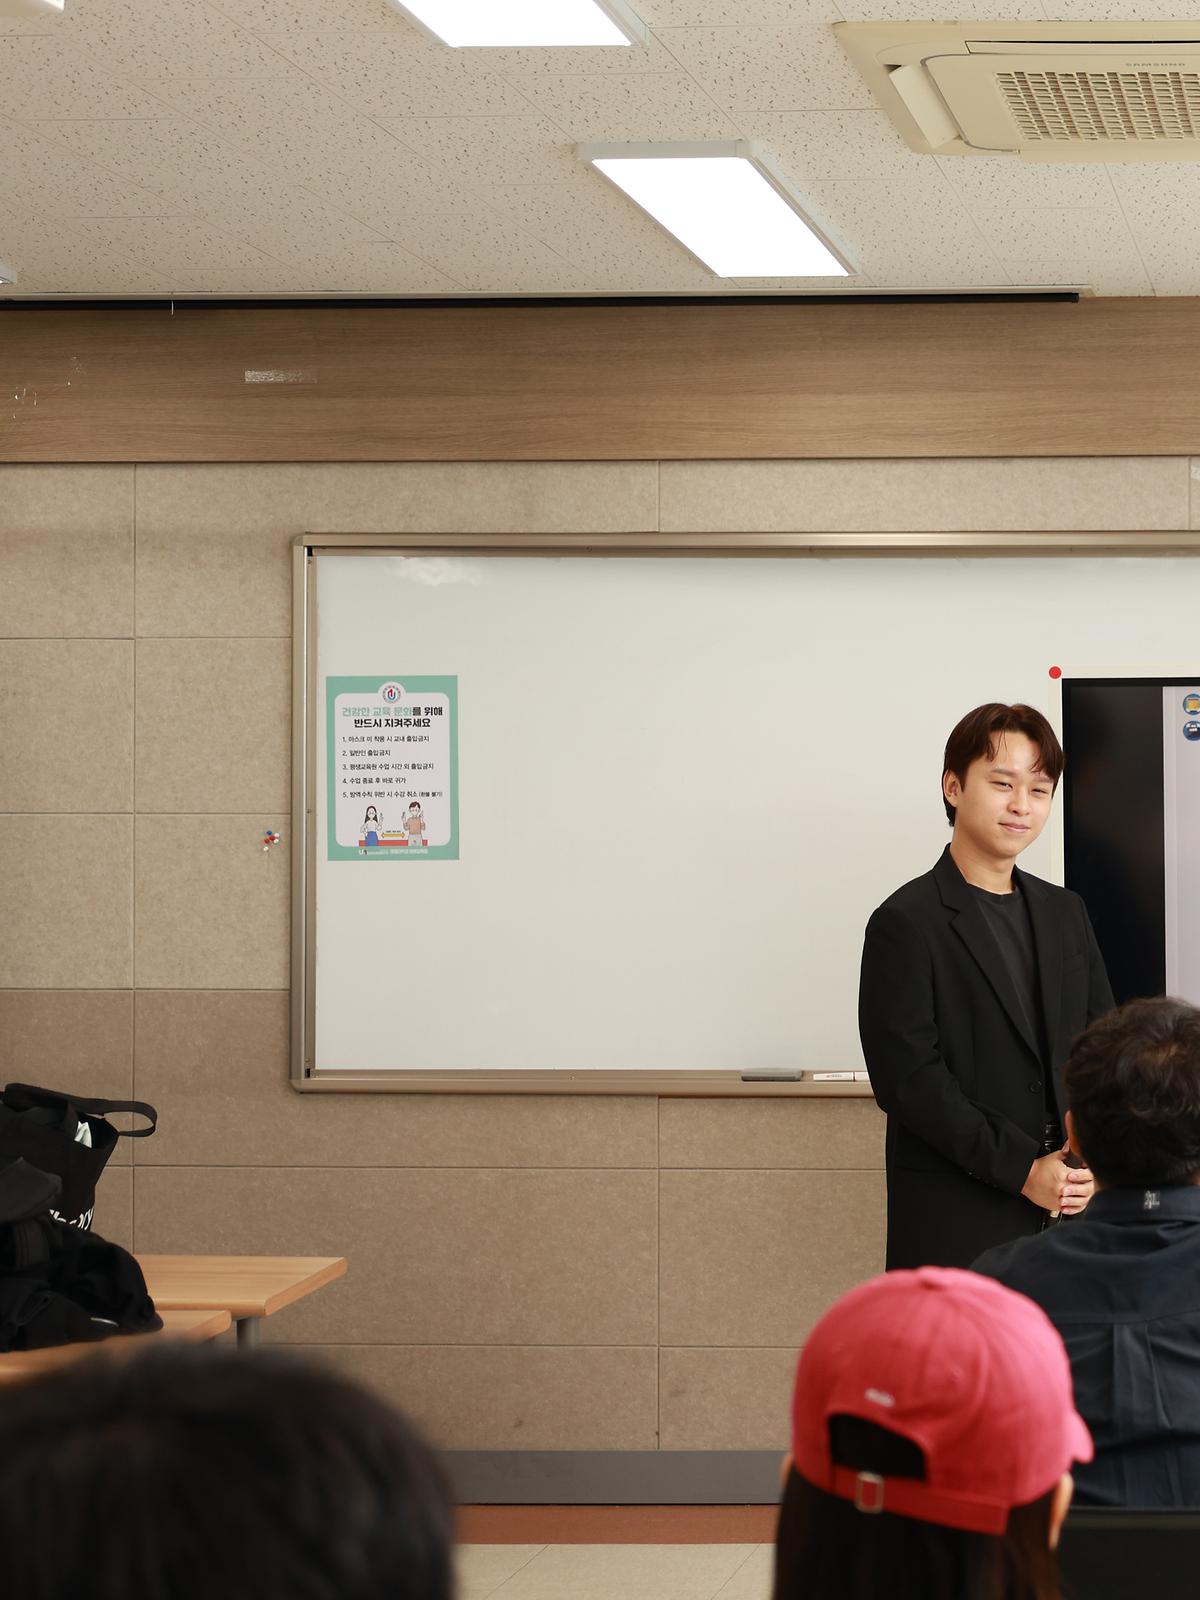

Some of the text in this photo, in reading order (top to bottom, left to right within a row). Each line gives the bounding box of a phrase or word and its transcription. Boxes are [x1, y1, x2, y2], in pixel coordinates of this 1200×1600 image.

[424, 706, 443, 717] 위해
[354, 718, 432, 728] 반드시 지켜주세요
[387, 735, 393, 743] 시
